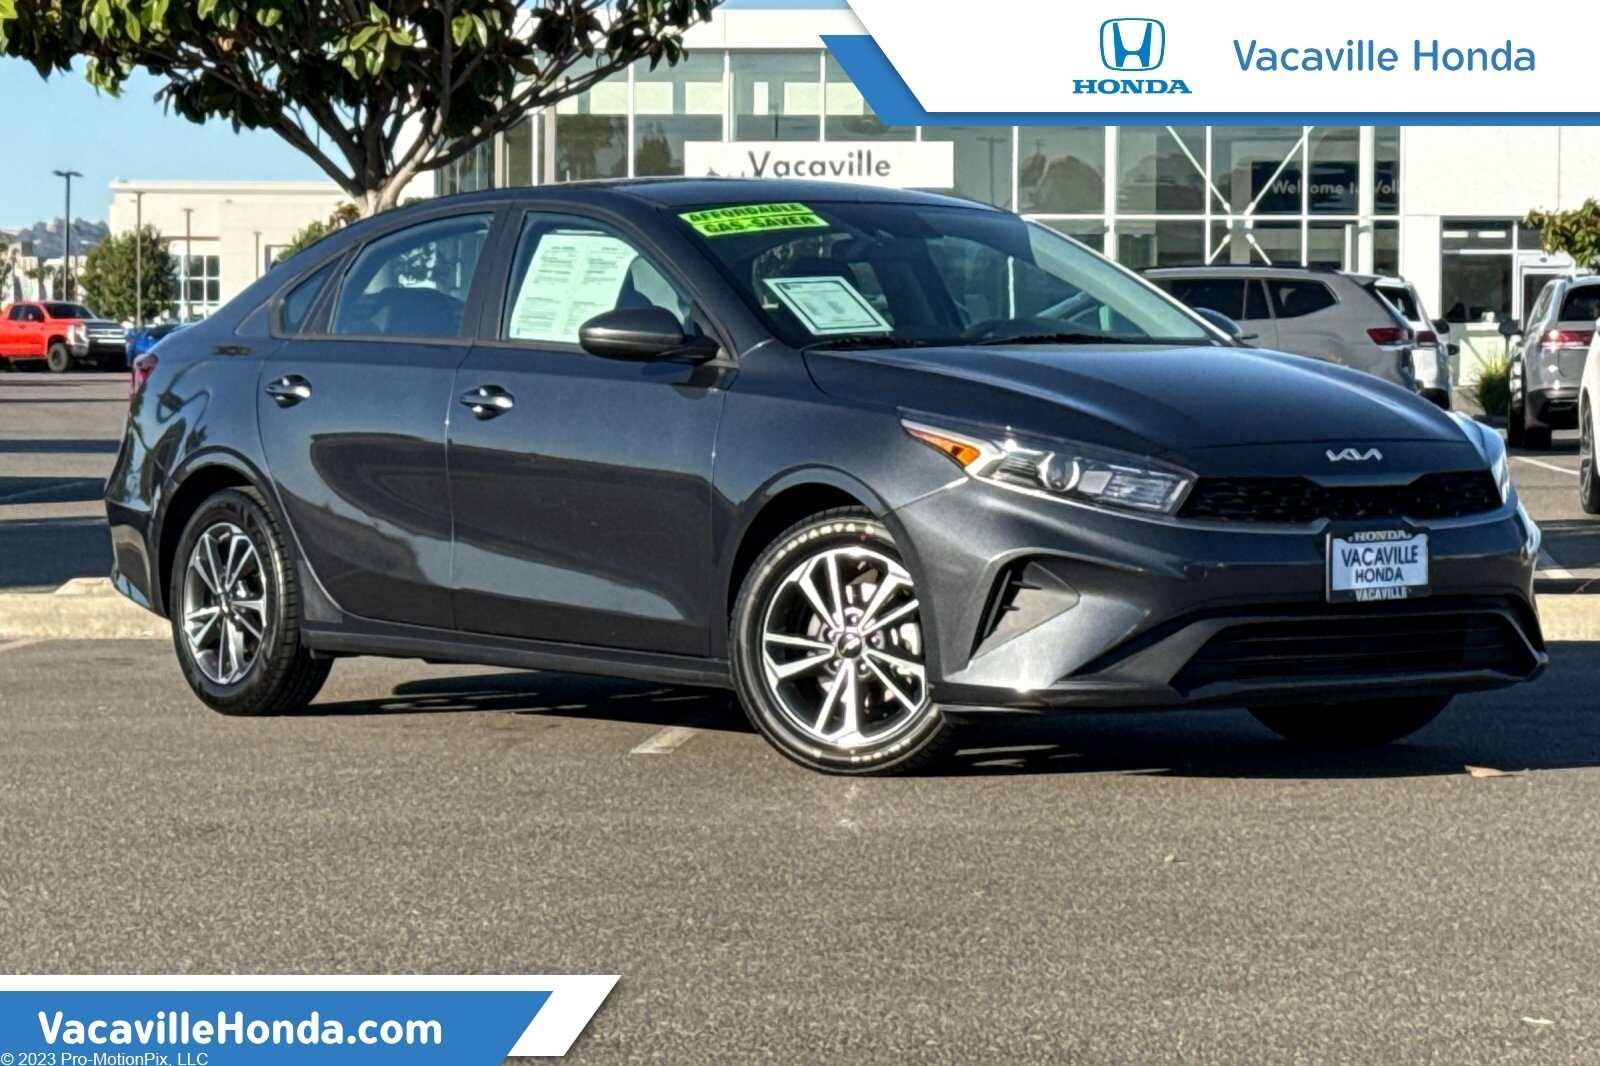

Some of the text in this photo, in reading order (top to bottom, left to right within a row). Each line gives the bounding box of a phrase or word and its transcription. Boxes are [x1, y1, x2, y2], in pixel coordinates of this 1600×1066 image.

[748, 149, 892, 177] Vacaville
[1271, 179, 1345, 195] Welome
[688, 203, 803, 223] AFFORDABLE
[1325, 448, 1383, 461] KIA
[1354, 530, 1408, 542] HONDA
[1341, 545, 1419, 567] VACAVILLE
[1355, 567, 1404, 583] HONDA
[1355, 587, 1408, 602] VACAVILLE
